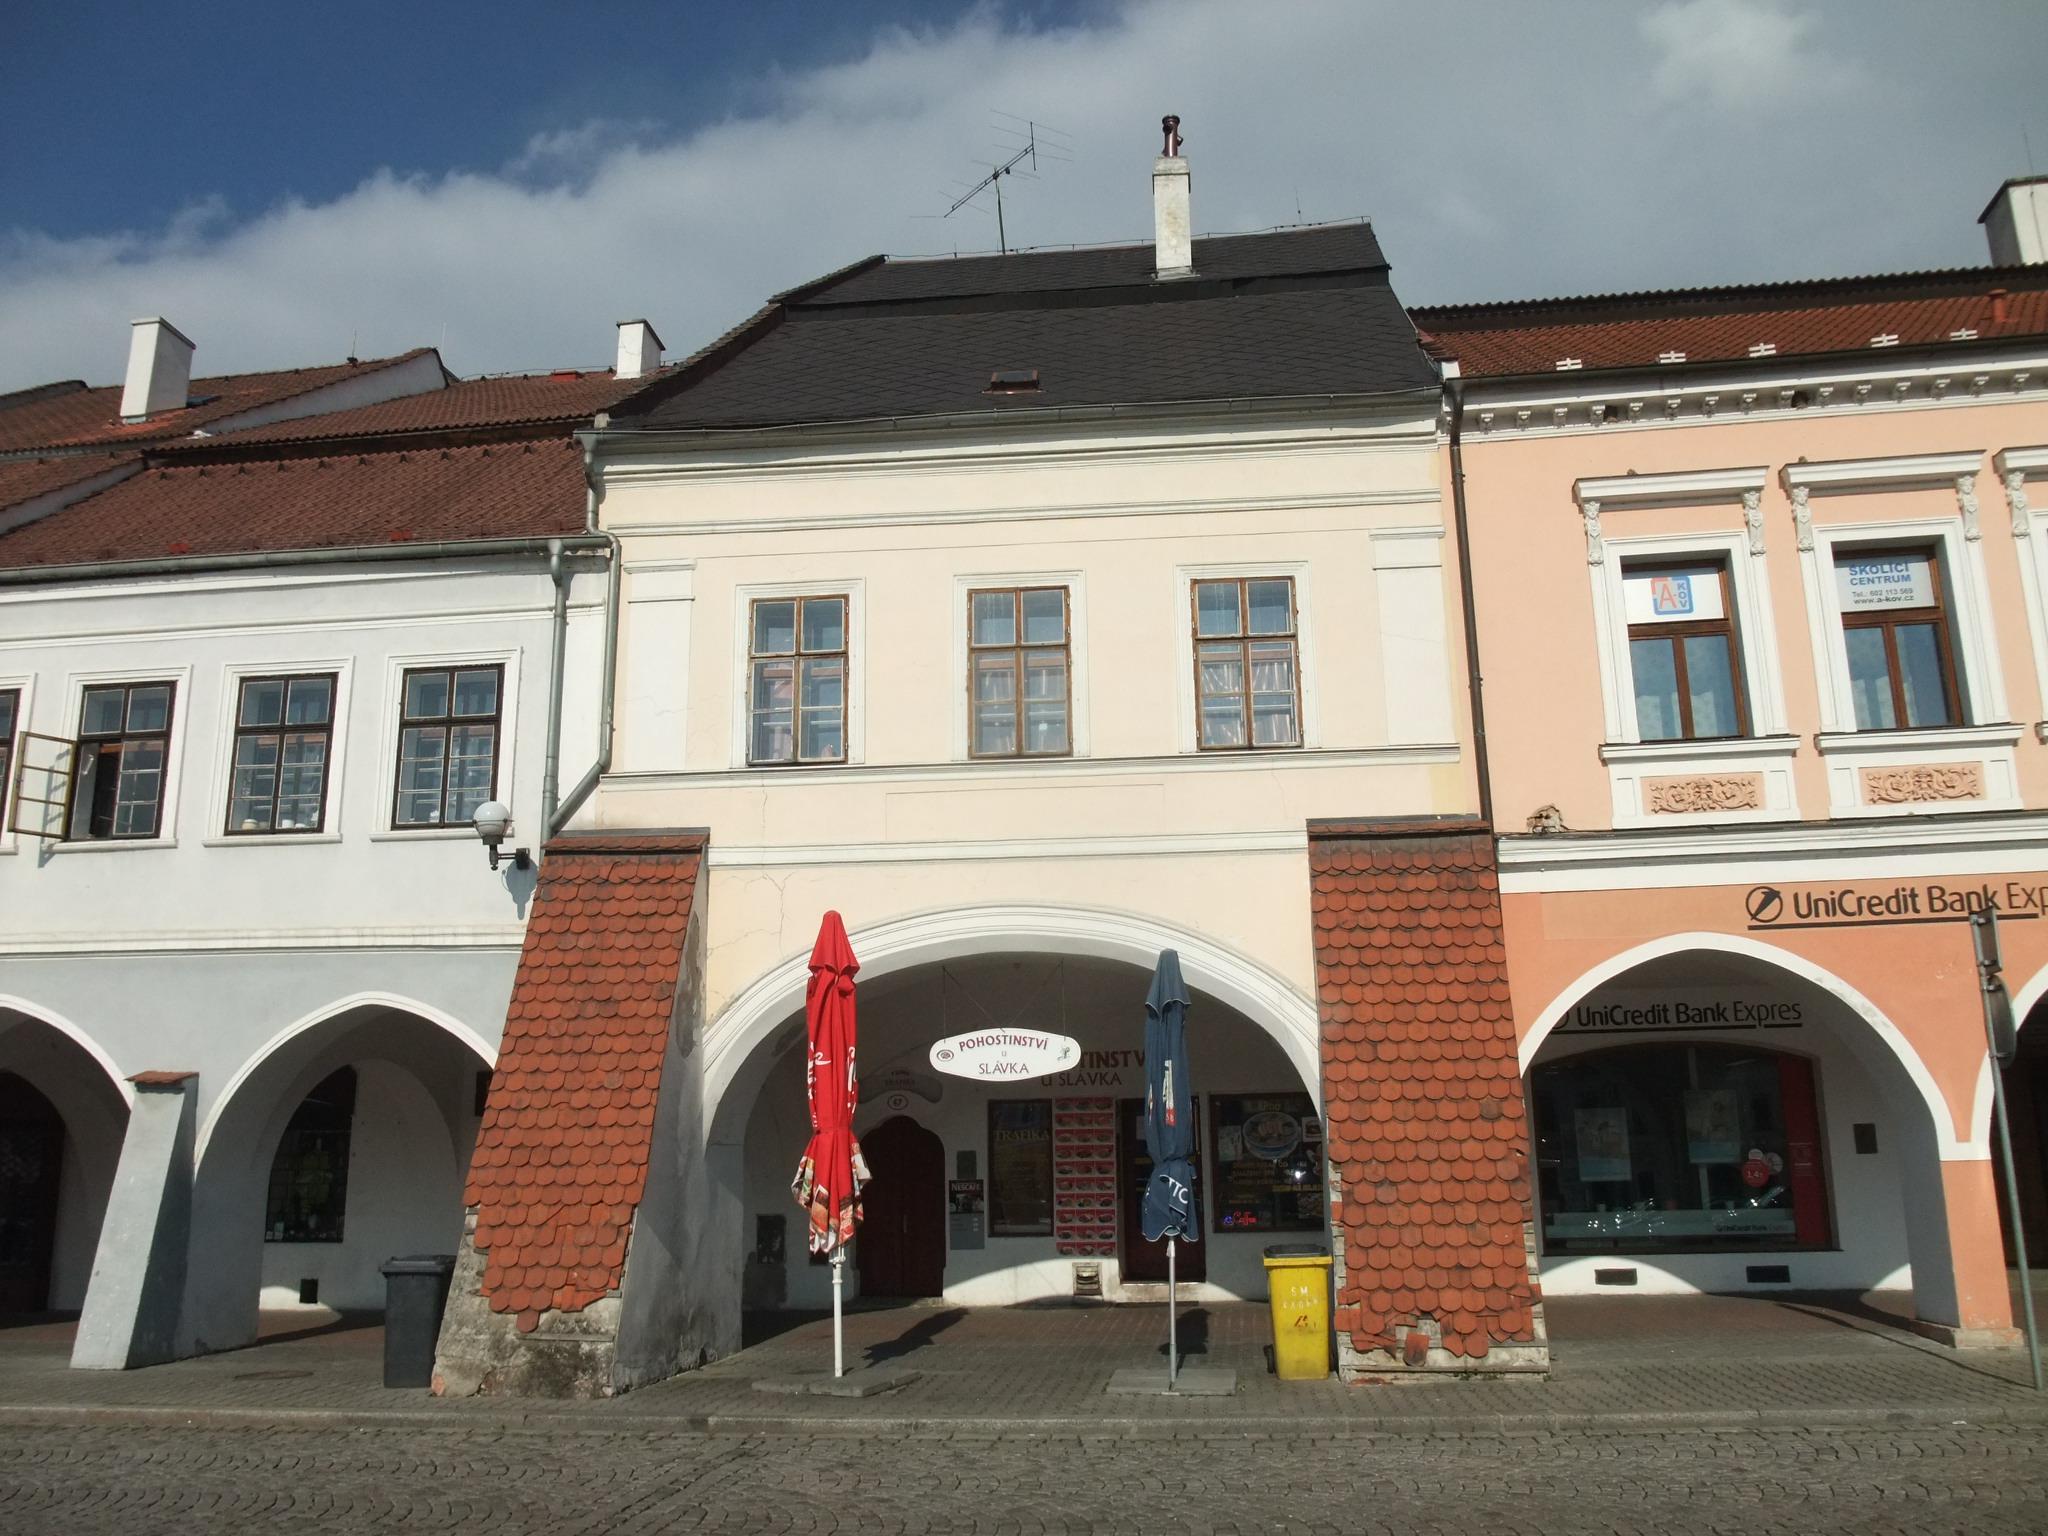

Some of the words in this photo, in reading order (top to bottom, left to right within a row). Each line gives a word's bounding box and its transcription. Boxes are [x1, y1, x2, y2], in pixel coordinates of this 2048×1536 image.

[1850, 574, 1911, 586] CENTRUM
[1853, 595, 1915, 605] www.a-kov.cz
[1793, 886, 1921, 919] UniCredit
[1927, 884, 2001, 914] Bank
[1577, 1003, 1670, 1027] UniCredit
[1676, 1002, 1728, 1025] Bank
[1733, 1000, 1802, 1027] Expres
[958, 1034, 1048, 1051] POHOSTINSTVÍ
[978, 1060, 1030, 1075] SLÁVKA
[993, 1128, 1050, 1142] TRAFIKA
